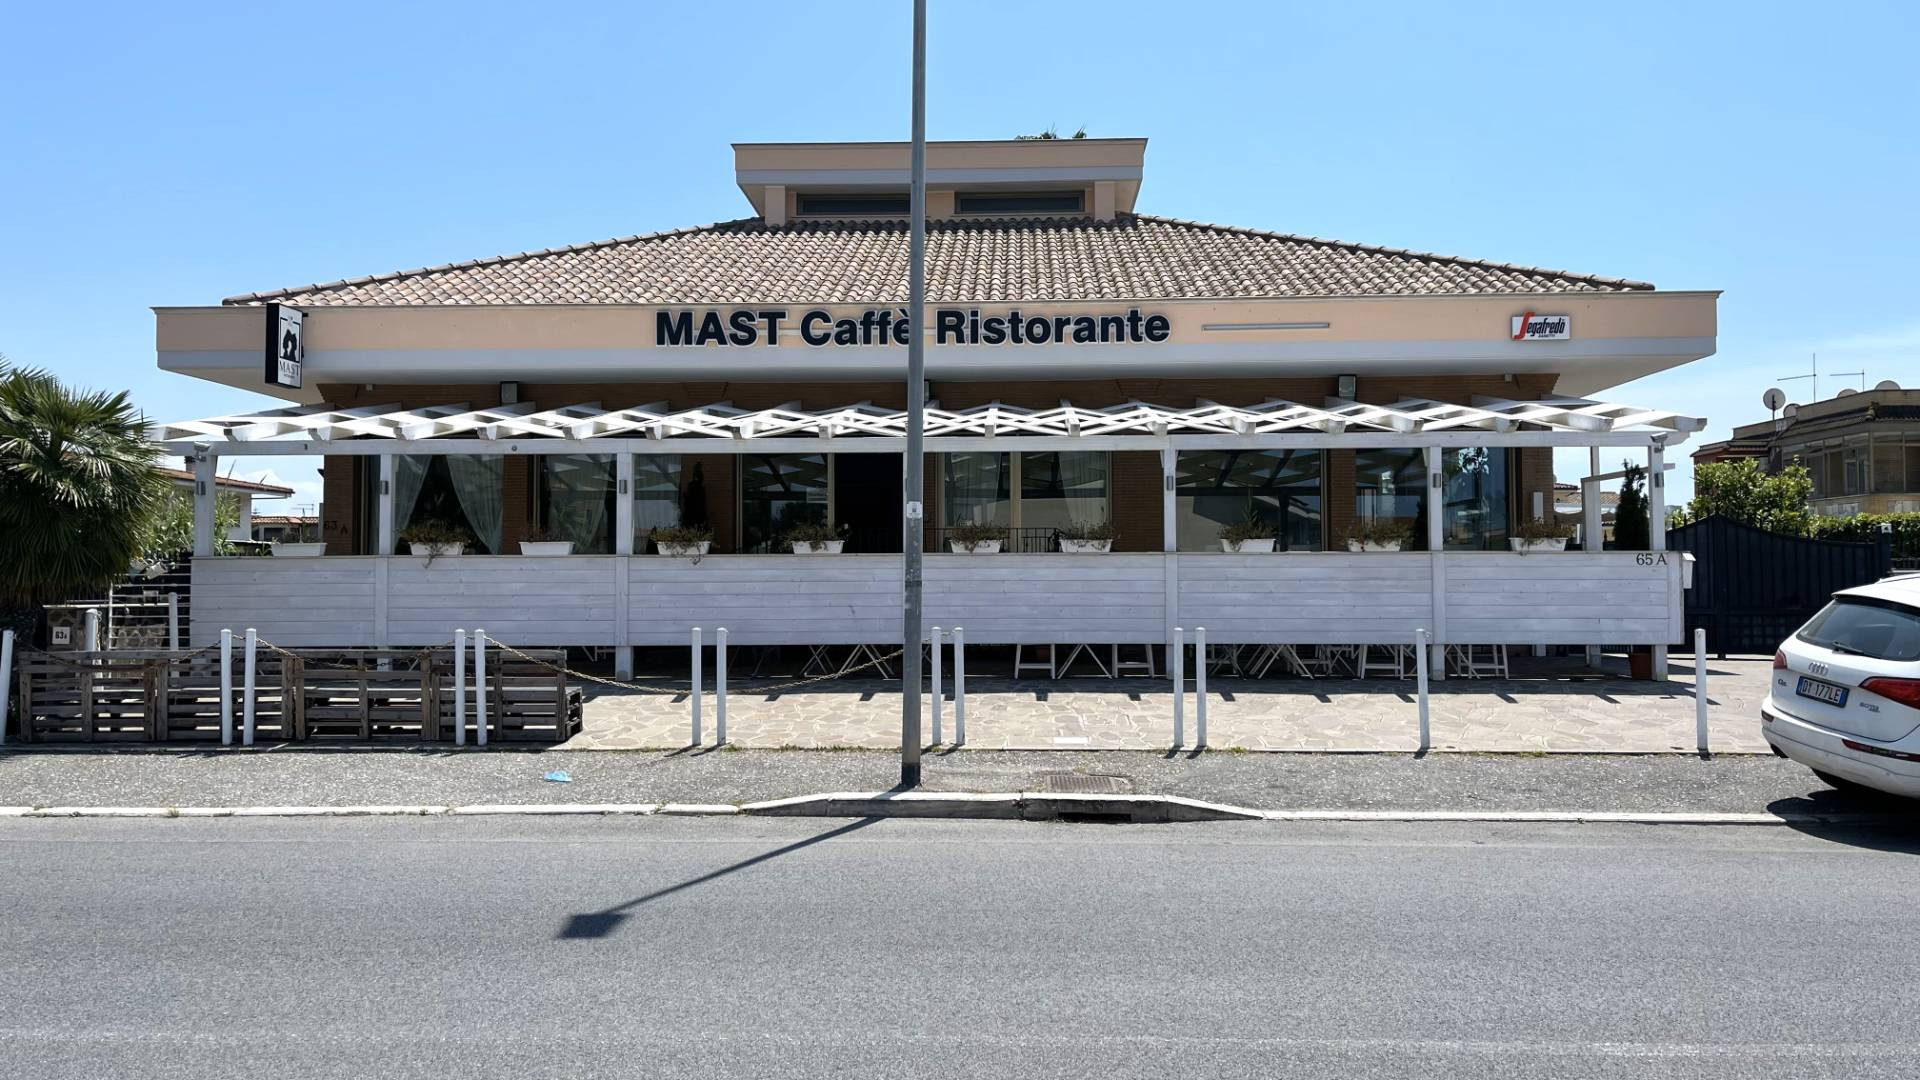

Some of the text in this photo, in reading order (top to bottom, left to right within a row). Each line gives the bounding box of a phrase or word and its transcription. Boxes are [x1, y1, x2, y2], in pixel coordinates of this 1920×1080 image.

[655, 308, 1171, 346] MAST Caffè Ristorante
[279, 360, 300, 376] MAST
[1636, 552, 1668, 566] 65 A
[1815, 683, 1841, 702] 177LE
